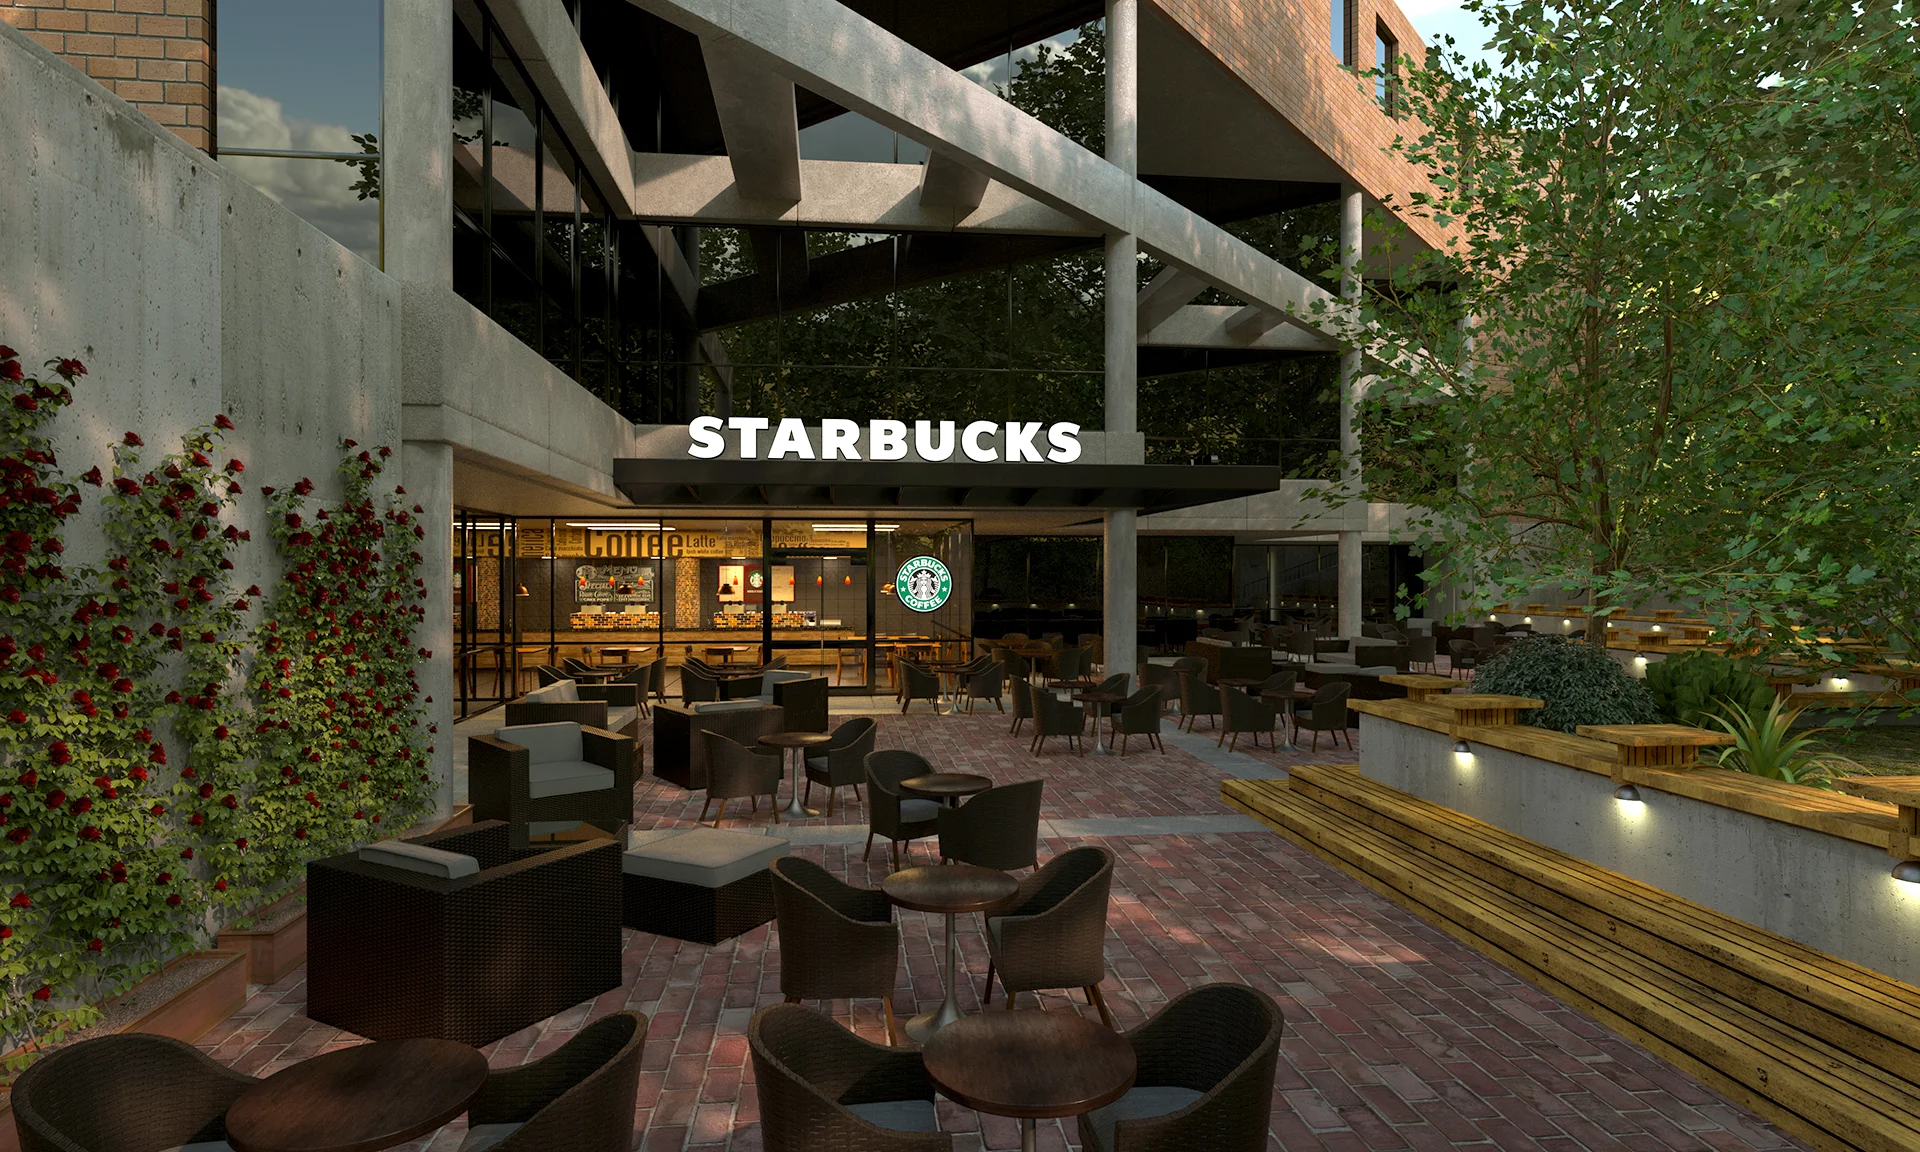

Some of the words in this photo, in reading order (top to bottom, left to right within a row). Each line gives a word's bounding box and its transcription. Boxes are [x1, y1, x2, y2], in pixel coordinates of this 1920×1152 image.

[687, 416, 1082, 463] STARBUCKS
[584, 529, 684, 557] Coffee
[686, 535, 716, 548] Latte
[900, 559, 949, 582] STARBUCKS
[905, 594, 942, 609] COFFEE
